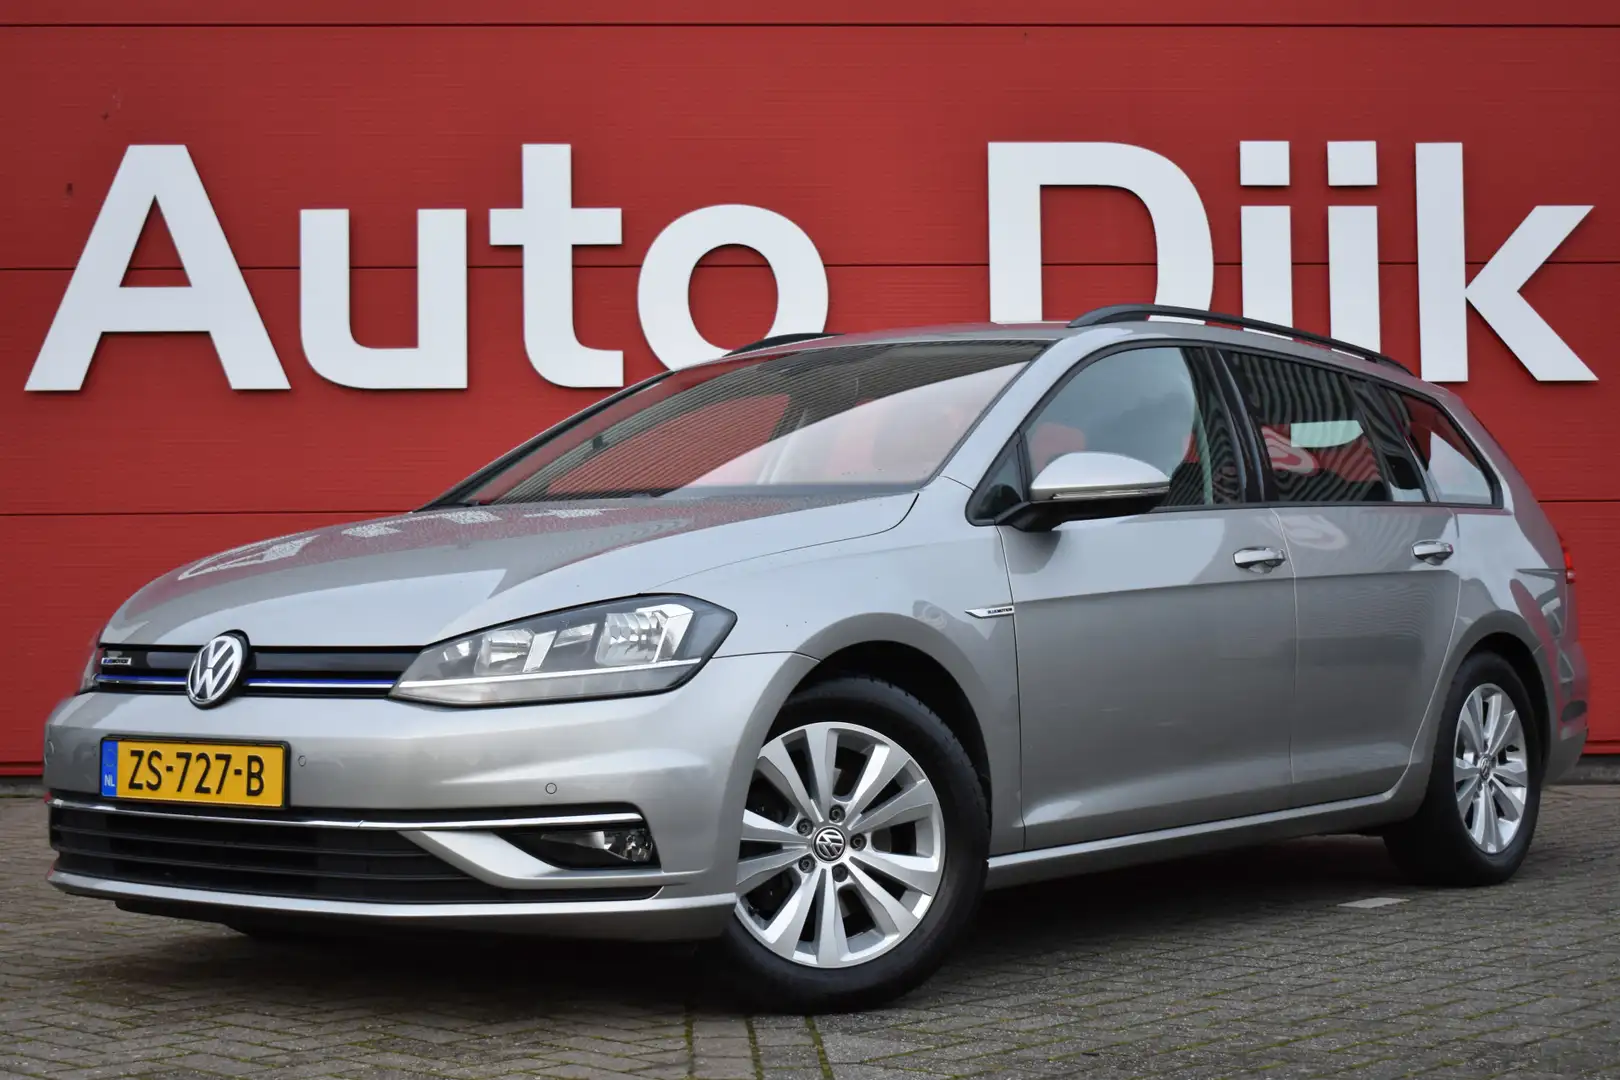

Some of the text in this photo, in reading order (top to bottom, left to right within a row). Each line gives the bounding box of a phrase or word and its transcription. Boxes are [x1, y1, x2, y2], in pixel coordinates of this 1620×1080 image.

[24, 140, 1600, 391] Auto Dijk
[104, 773, 116, 788] NL
[128, 749, 265, 797] ZS-727-B
